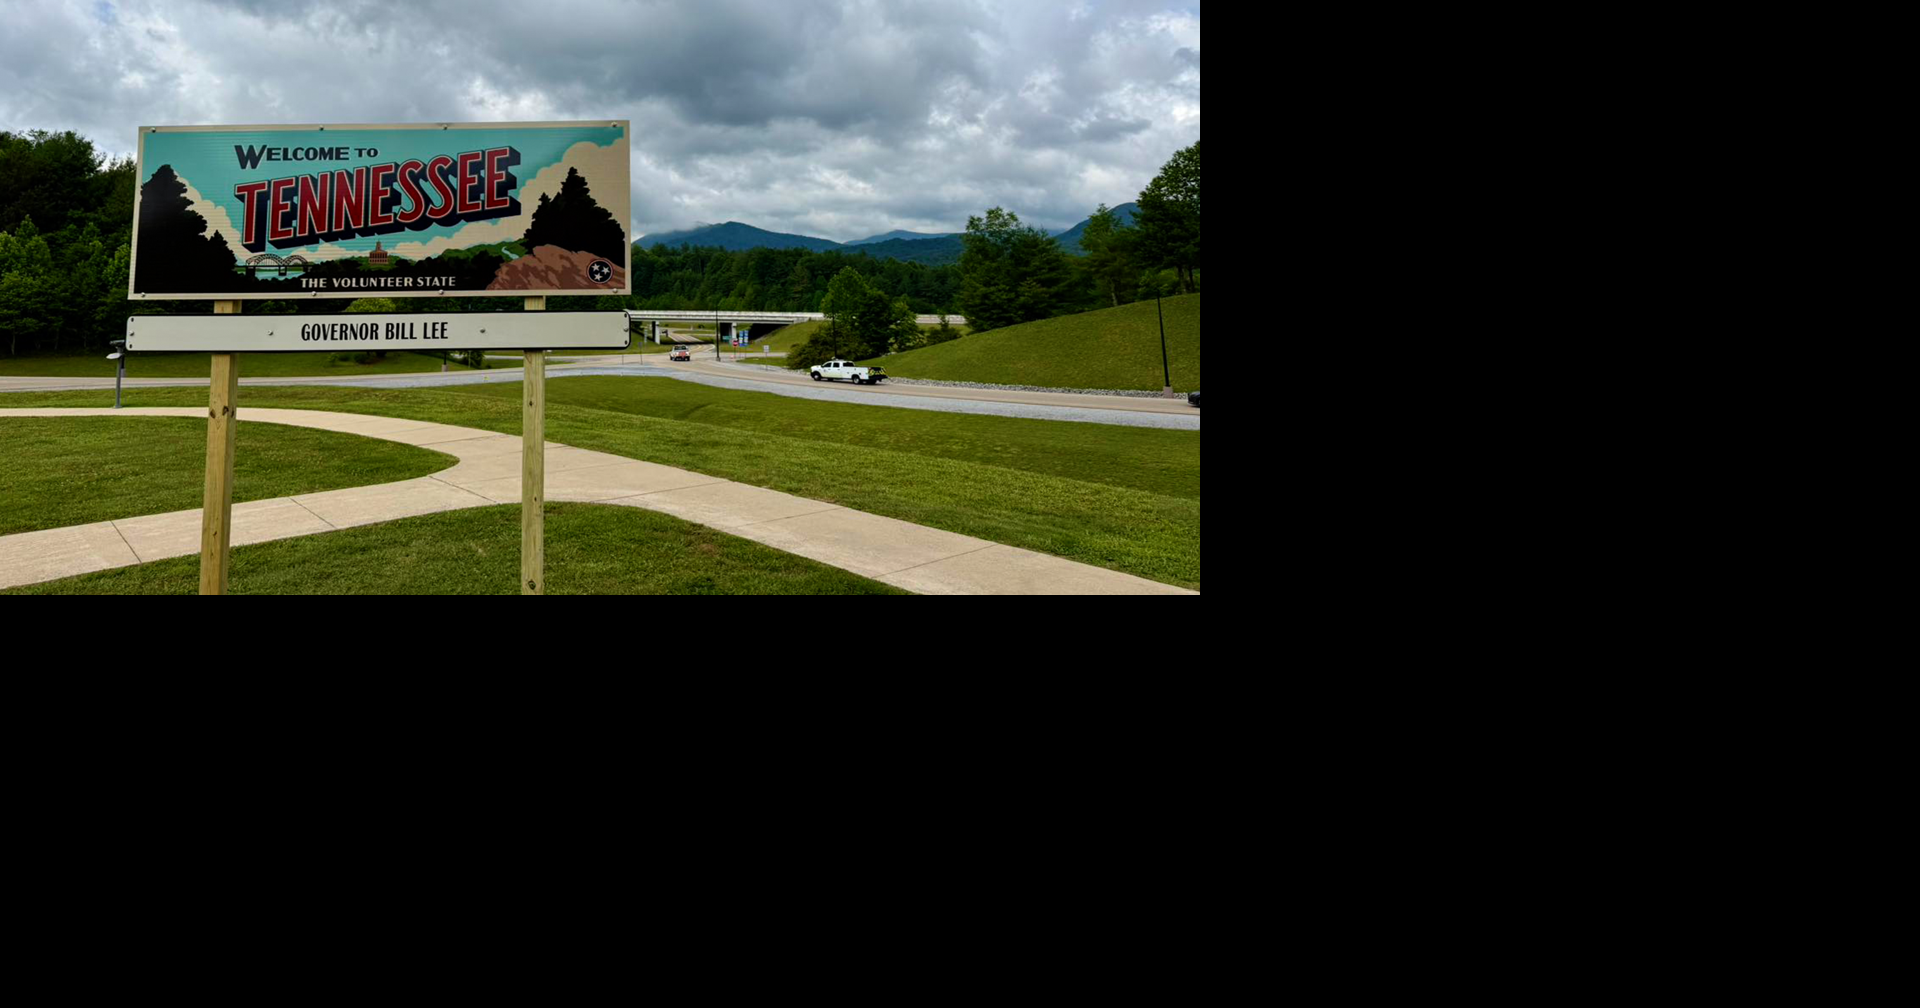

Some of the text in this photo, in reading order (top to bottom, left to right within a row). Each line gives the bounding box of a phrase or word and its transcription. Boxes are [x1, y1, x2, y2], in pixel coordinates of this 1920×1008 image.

[234, 145, 378, 169] WELCOME TO
[234, 146, 521, 253] TENNESSEE
[300, 276, 456, 288] THE VOLUNTEER STATE
[301, 321, 448, 341] GOVERNOR BILL LEE
